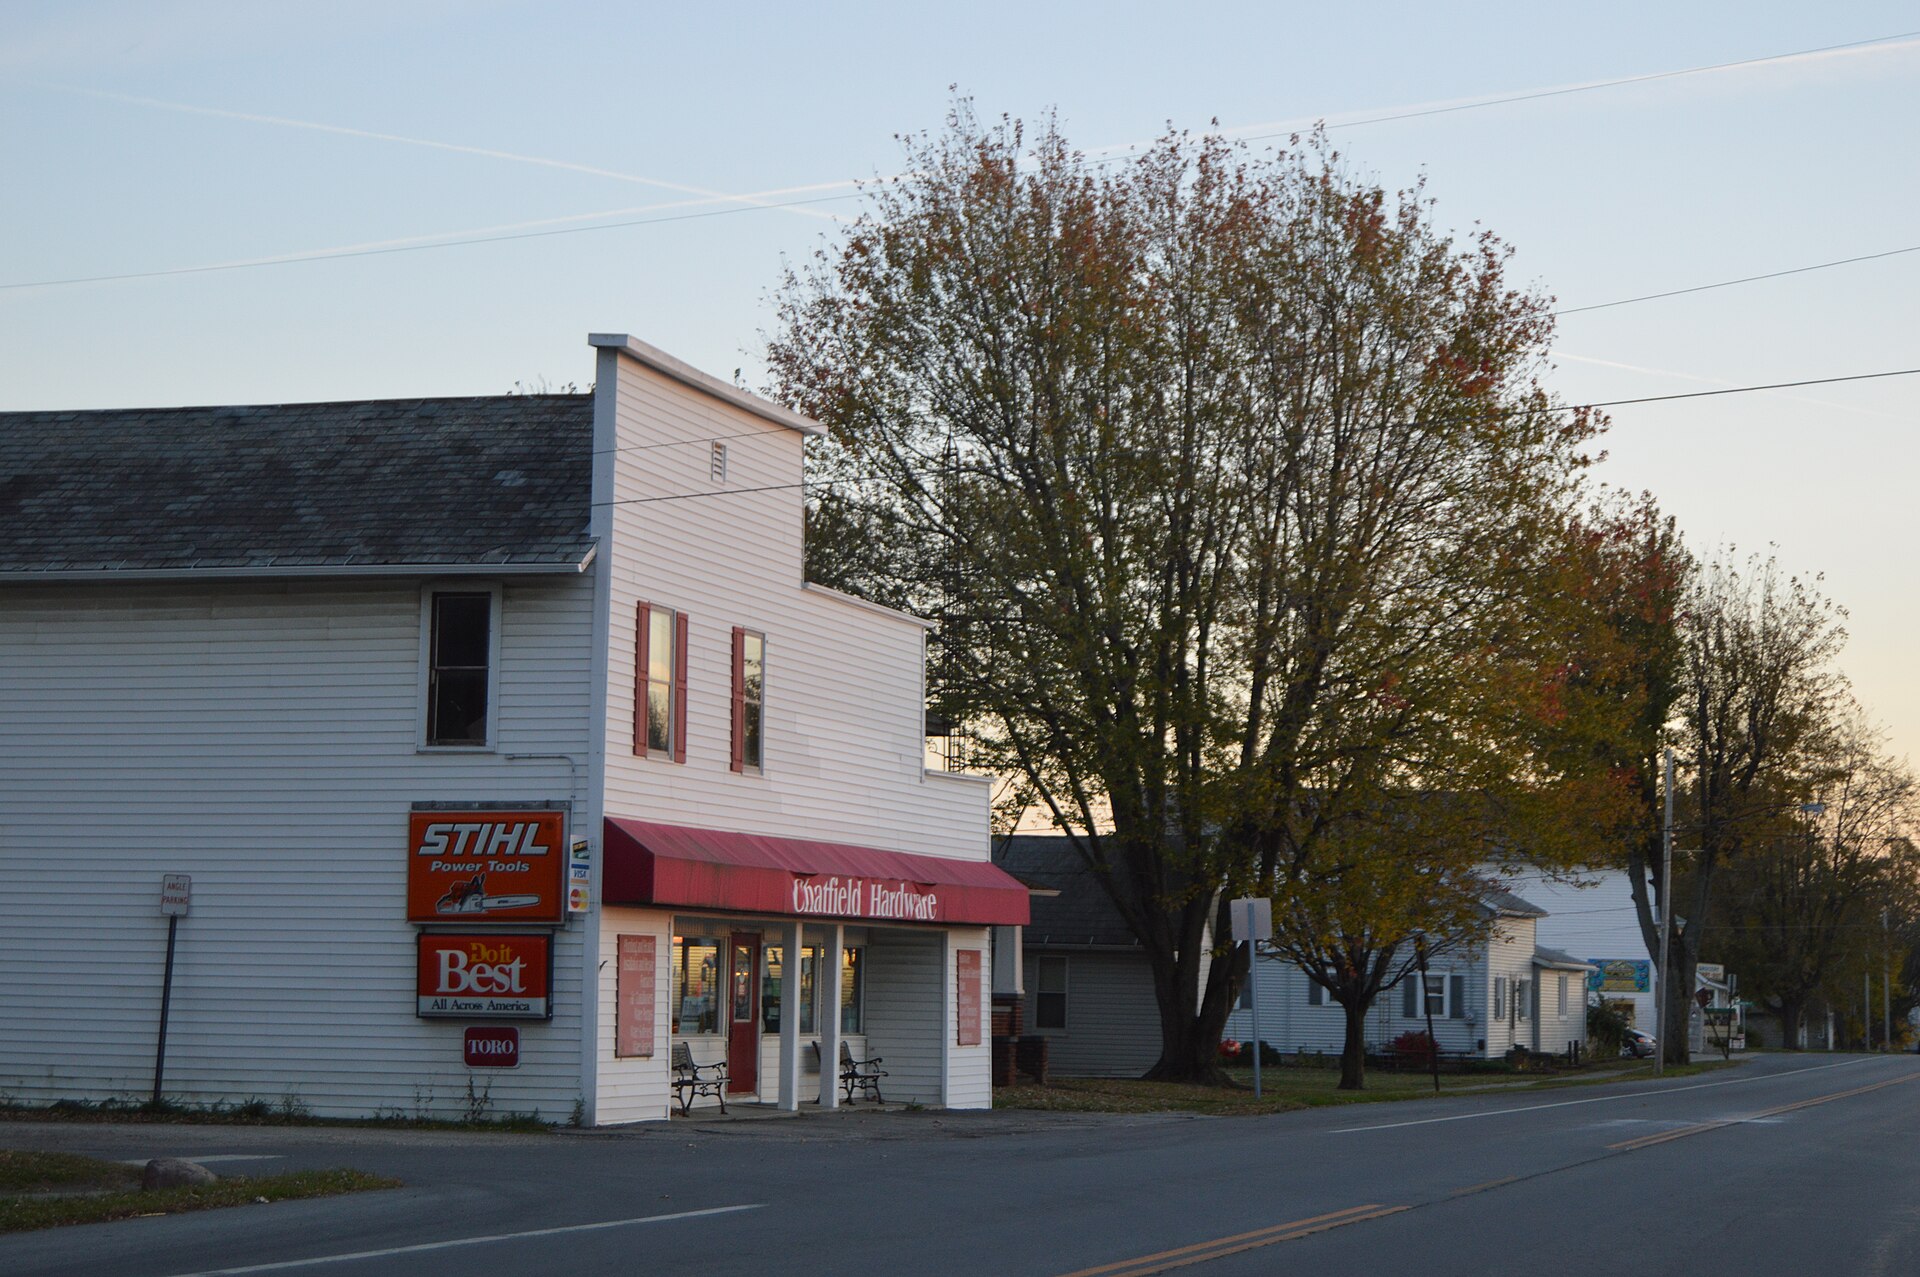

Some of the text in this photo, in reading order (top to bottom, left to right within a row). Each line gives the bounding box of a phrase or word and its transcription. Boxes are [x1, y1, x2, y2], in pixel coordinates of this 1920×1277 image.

[418, 822, 549, 856] STIHL
[431, 860, 530, 872] Power Tools
[574, 869, 587, 878] VISA
[167, 882, 187, 890] ANGLE
[161, 896, 188, 905] PARKING
[793, 877, 938, 920] Chatfield Hardware
[470, 942, 513, 963] Do it
[436, 949, 527, 993] Best
[431, 998, 530, 1012] All Across America
[468, 1039, 514, 1054] TORO
